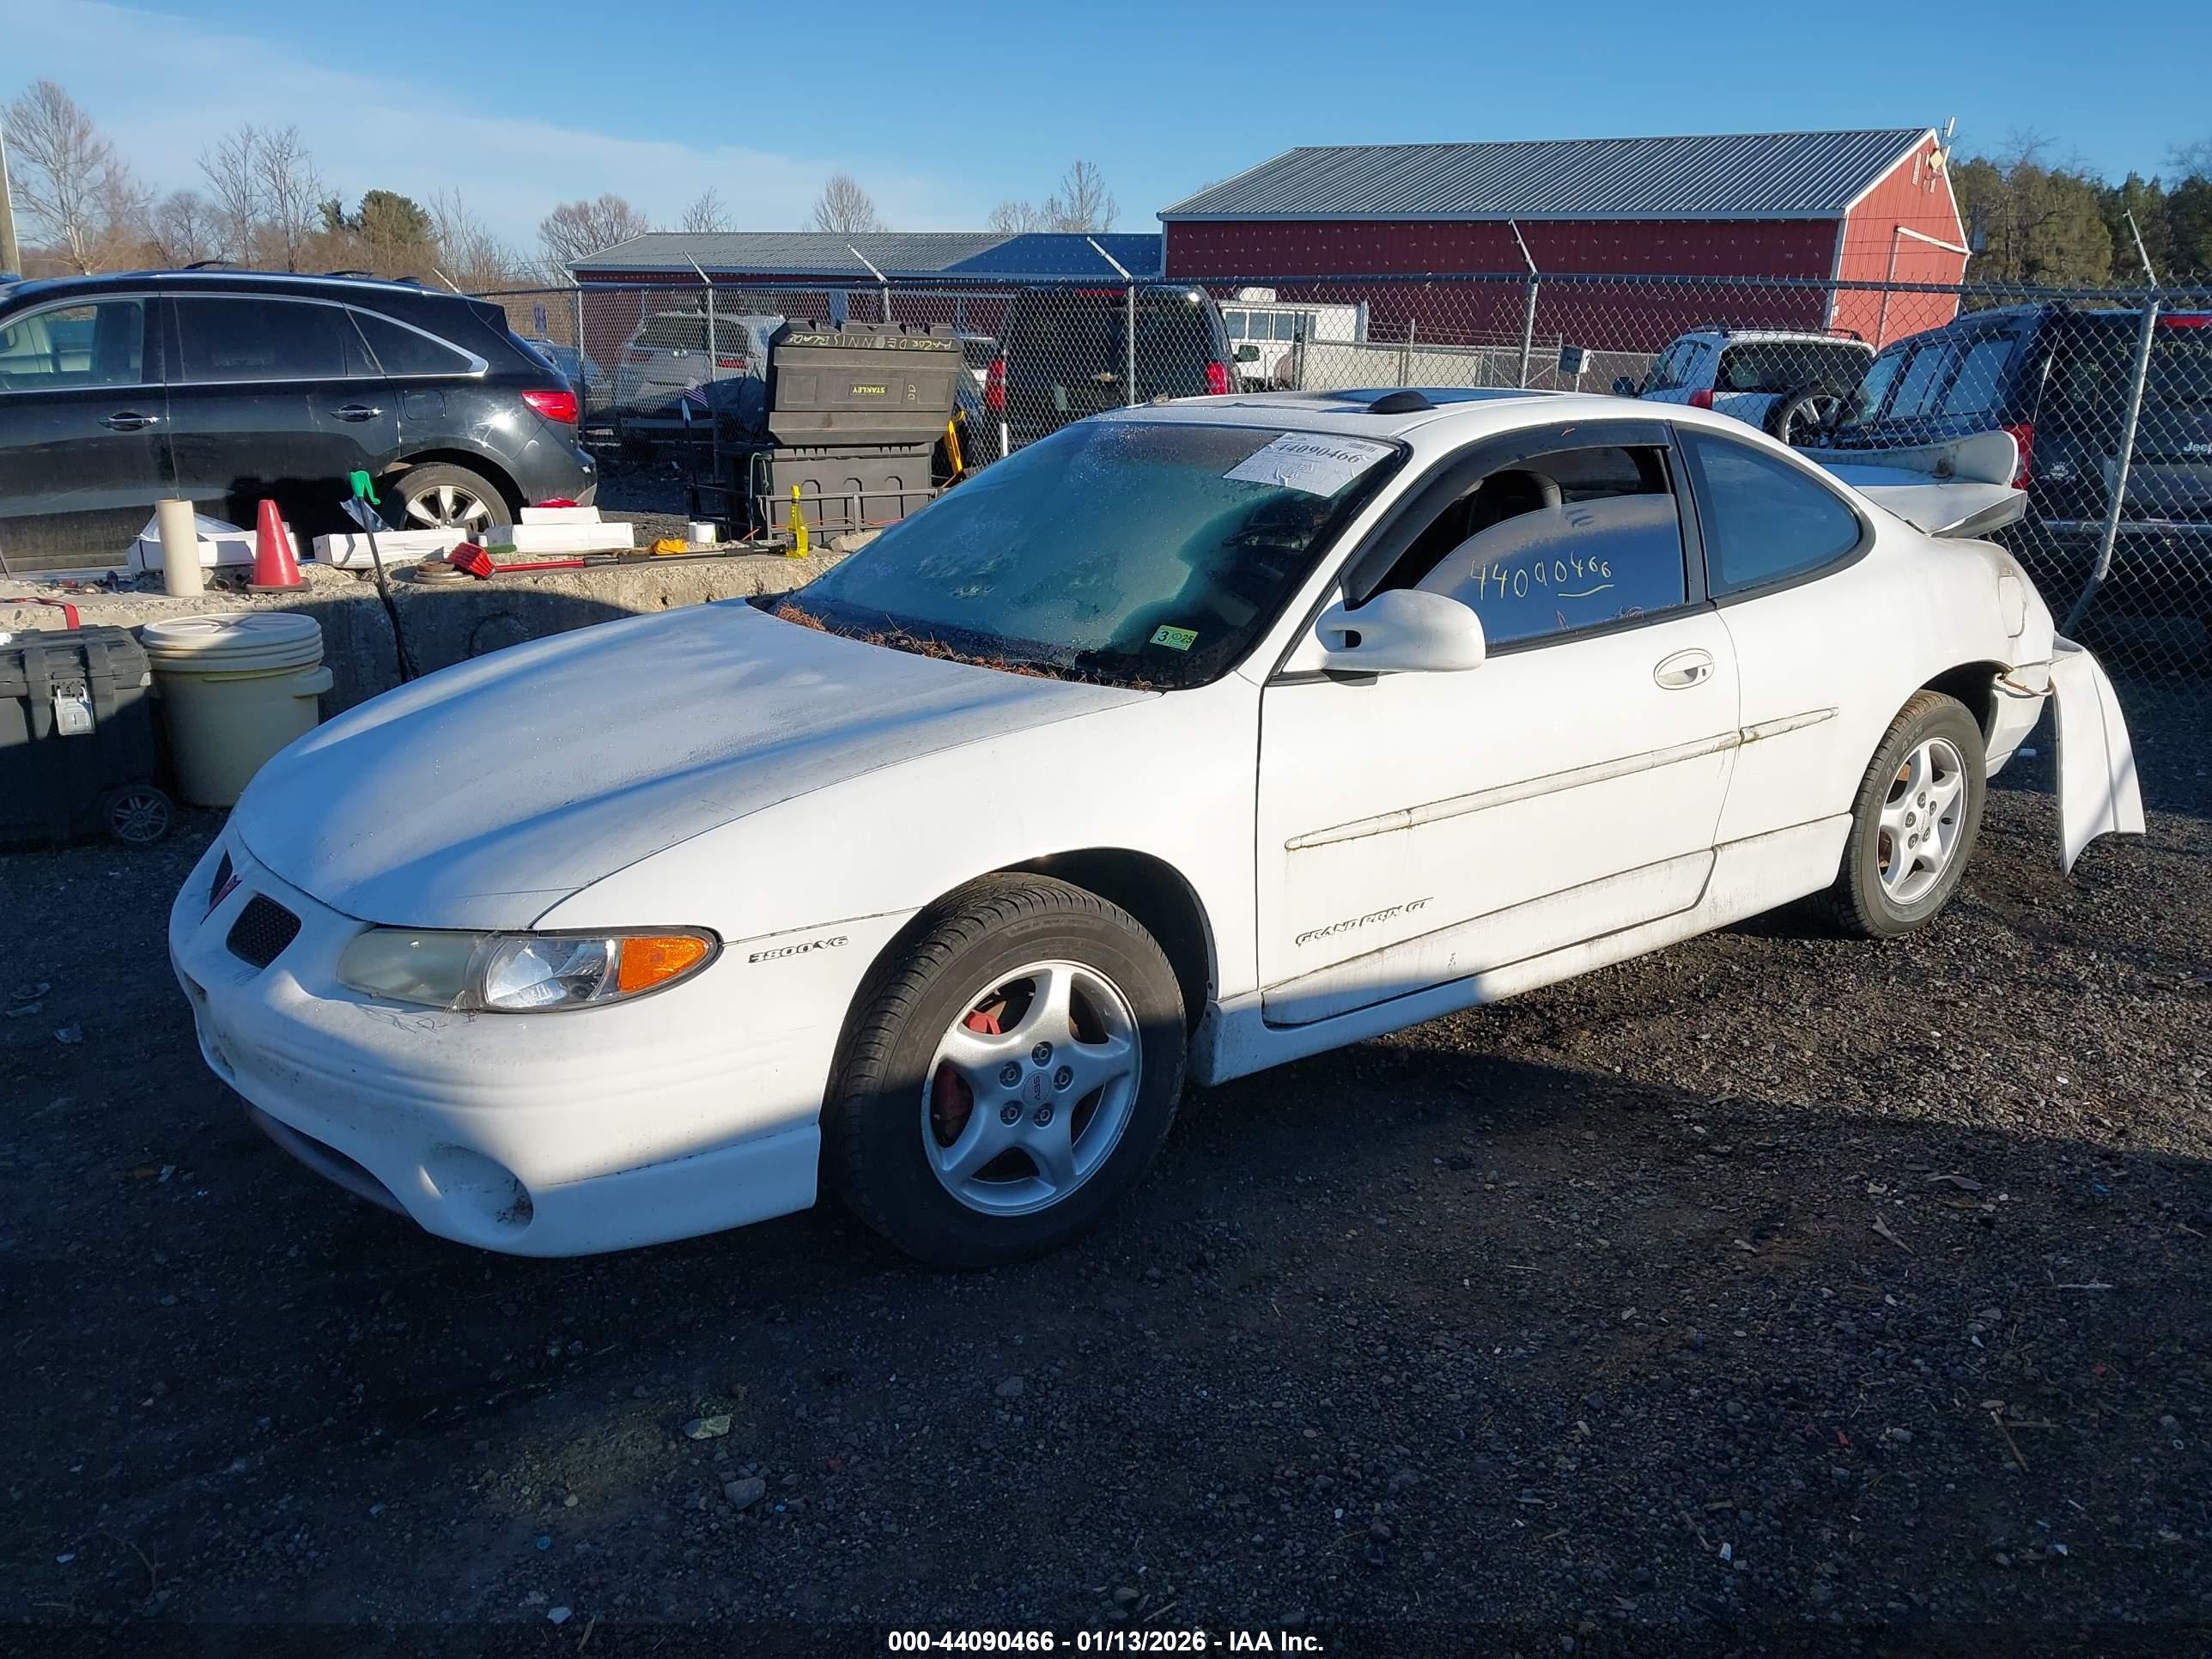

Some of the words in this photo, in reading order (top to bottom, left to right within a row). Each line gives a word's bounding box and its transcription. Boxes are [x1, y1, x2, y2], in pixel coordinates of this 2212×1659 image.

[1276, 444, 1361, 464] 44090466
[1470, 550, 1613, 601] 44090466
[1158, 630, 1169, 641] 3
[1181, 635, 1194, 644] 25
[1033, 1075, 1042, 1101] ABS
